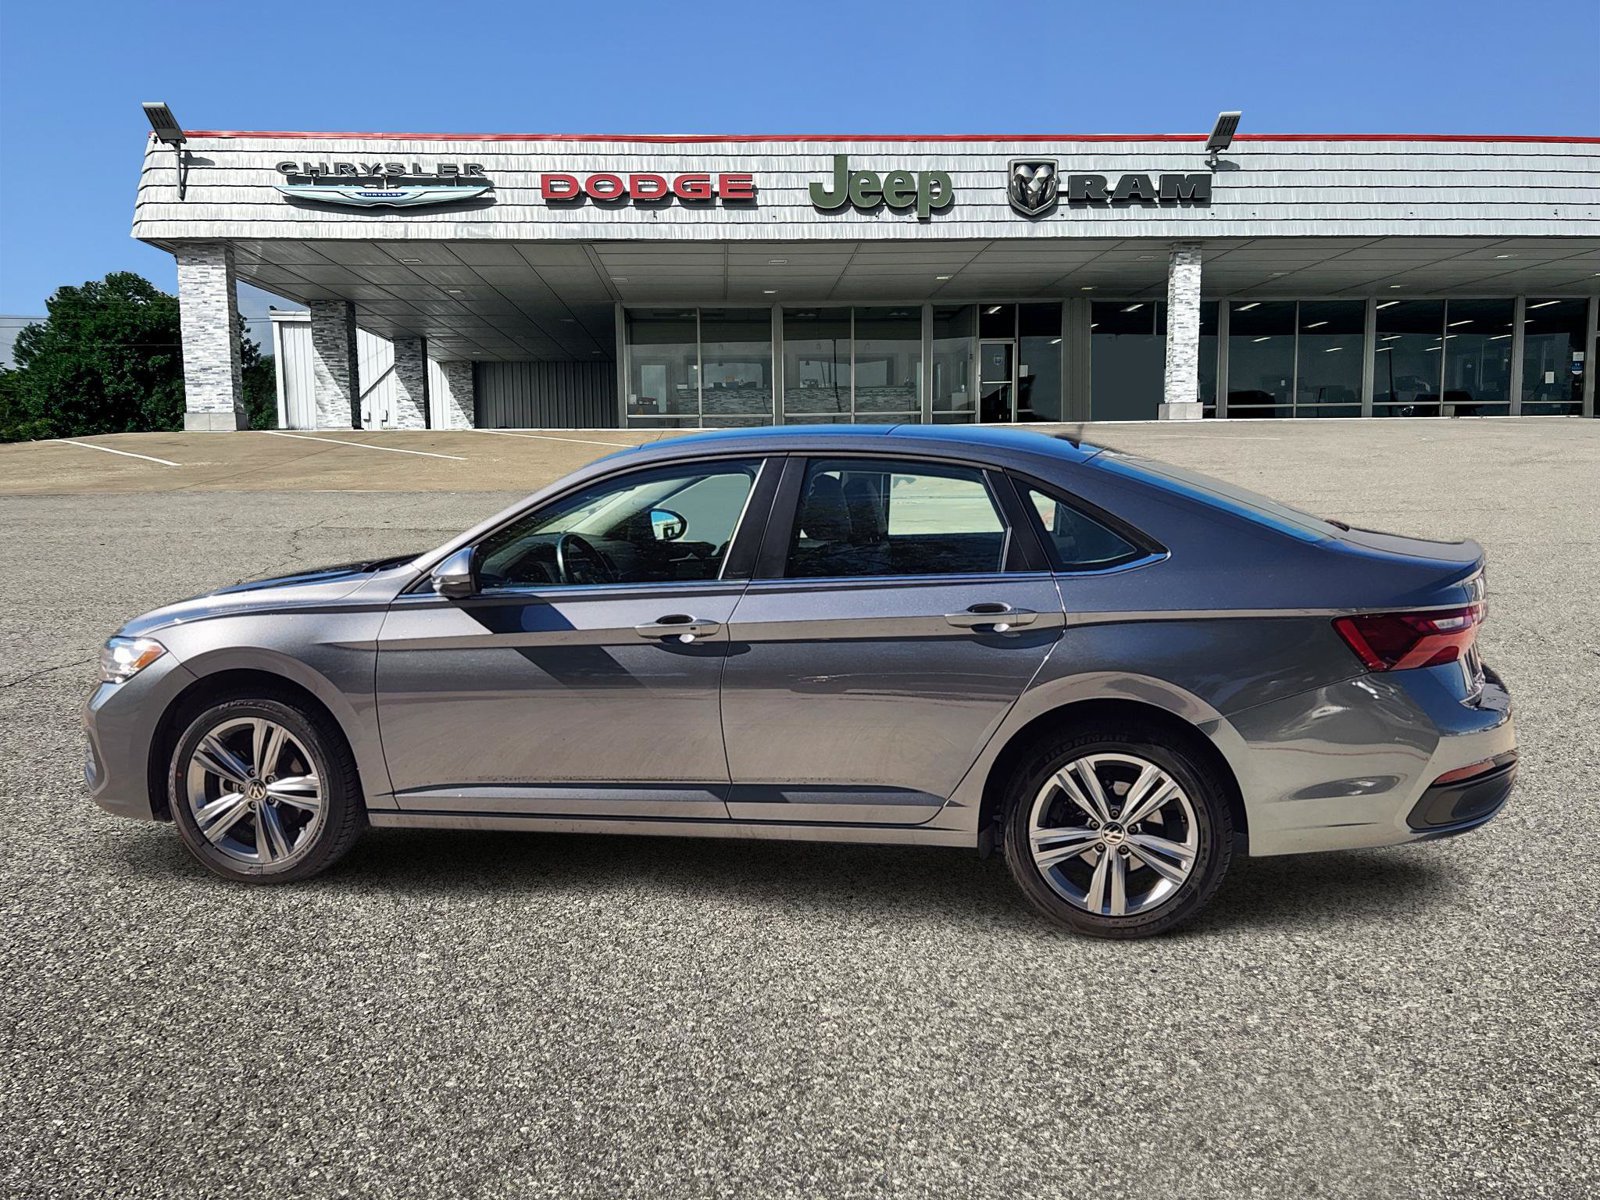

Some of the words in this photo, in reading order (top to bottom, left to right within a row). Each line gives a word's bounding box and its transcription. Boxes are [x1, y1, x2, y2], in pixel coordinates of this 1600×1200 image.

[275, 161, 487, 178] CHRYSLER
[541, 173, 755, 200] DODGE
[808, 154, 953, 219] Jeep
[1067, 173, 1213, 200] RAM
